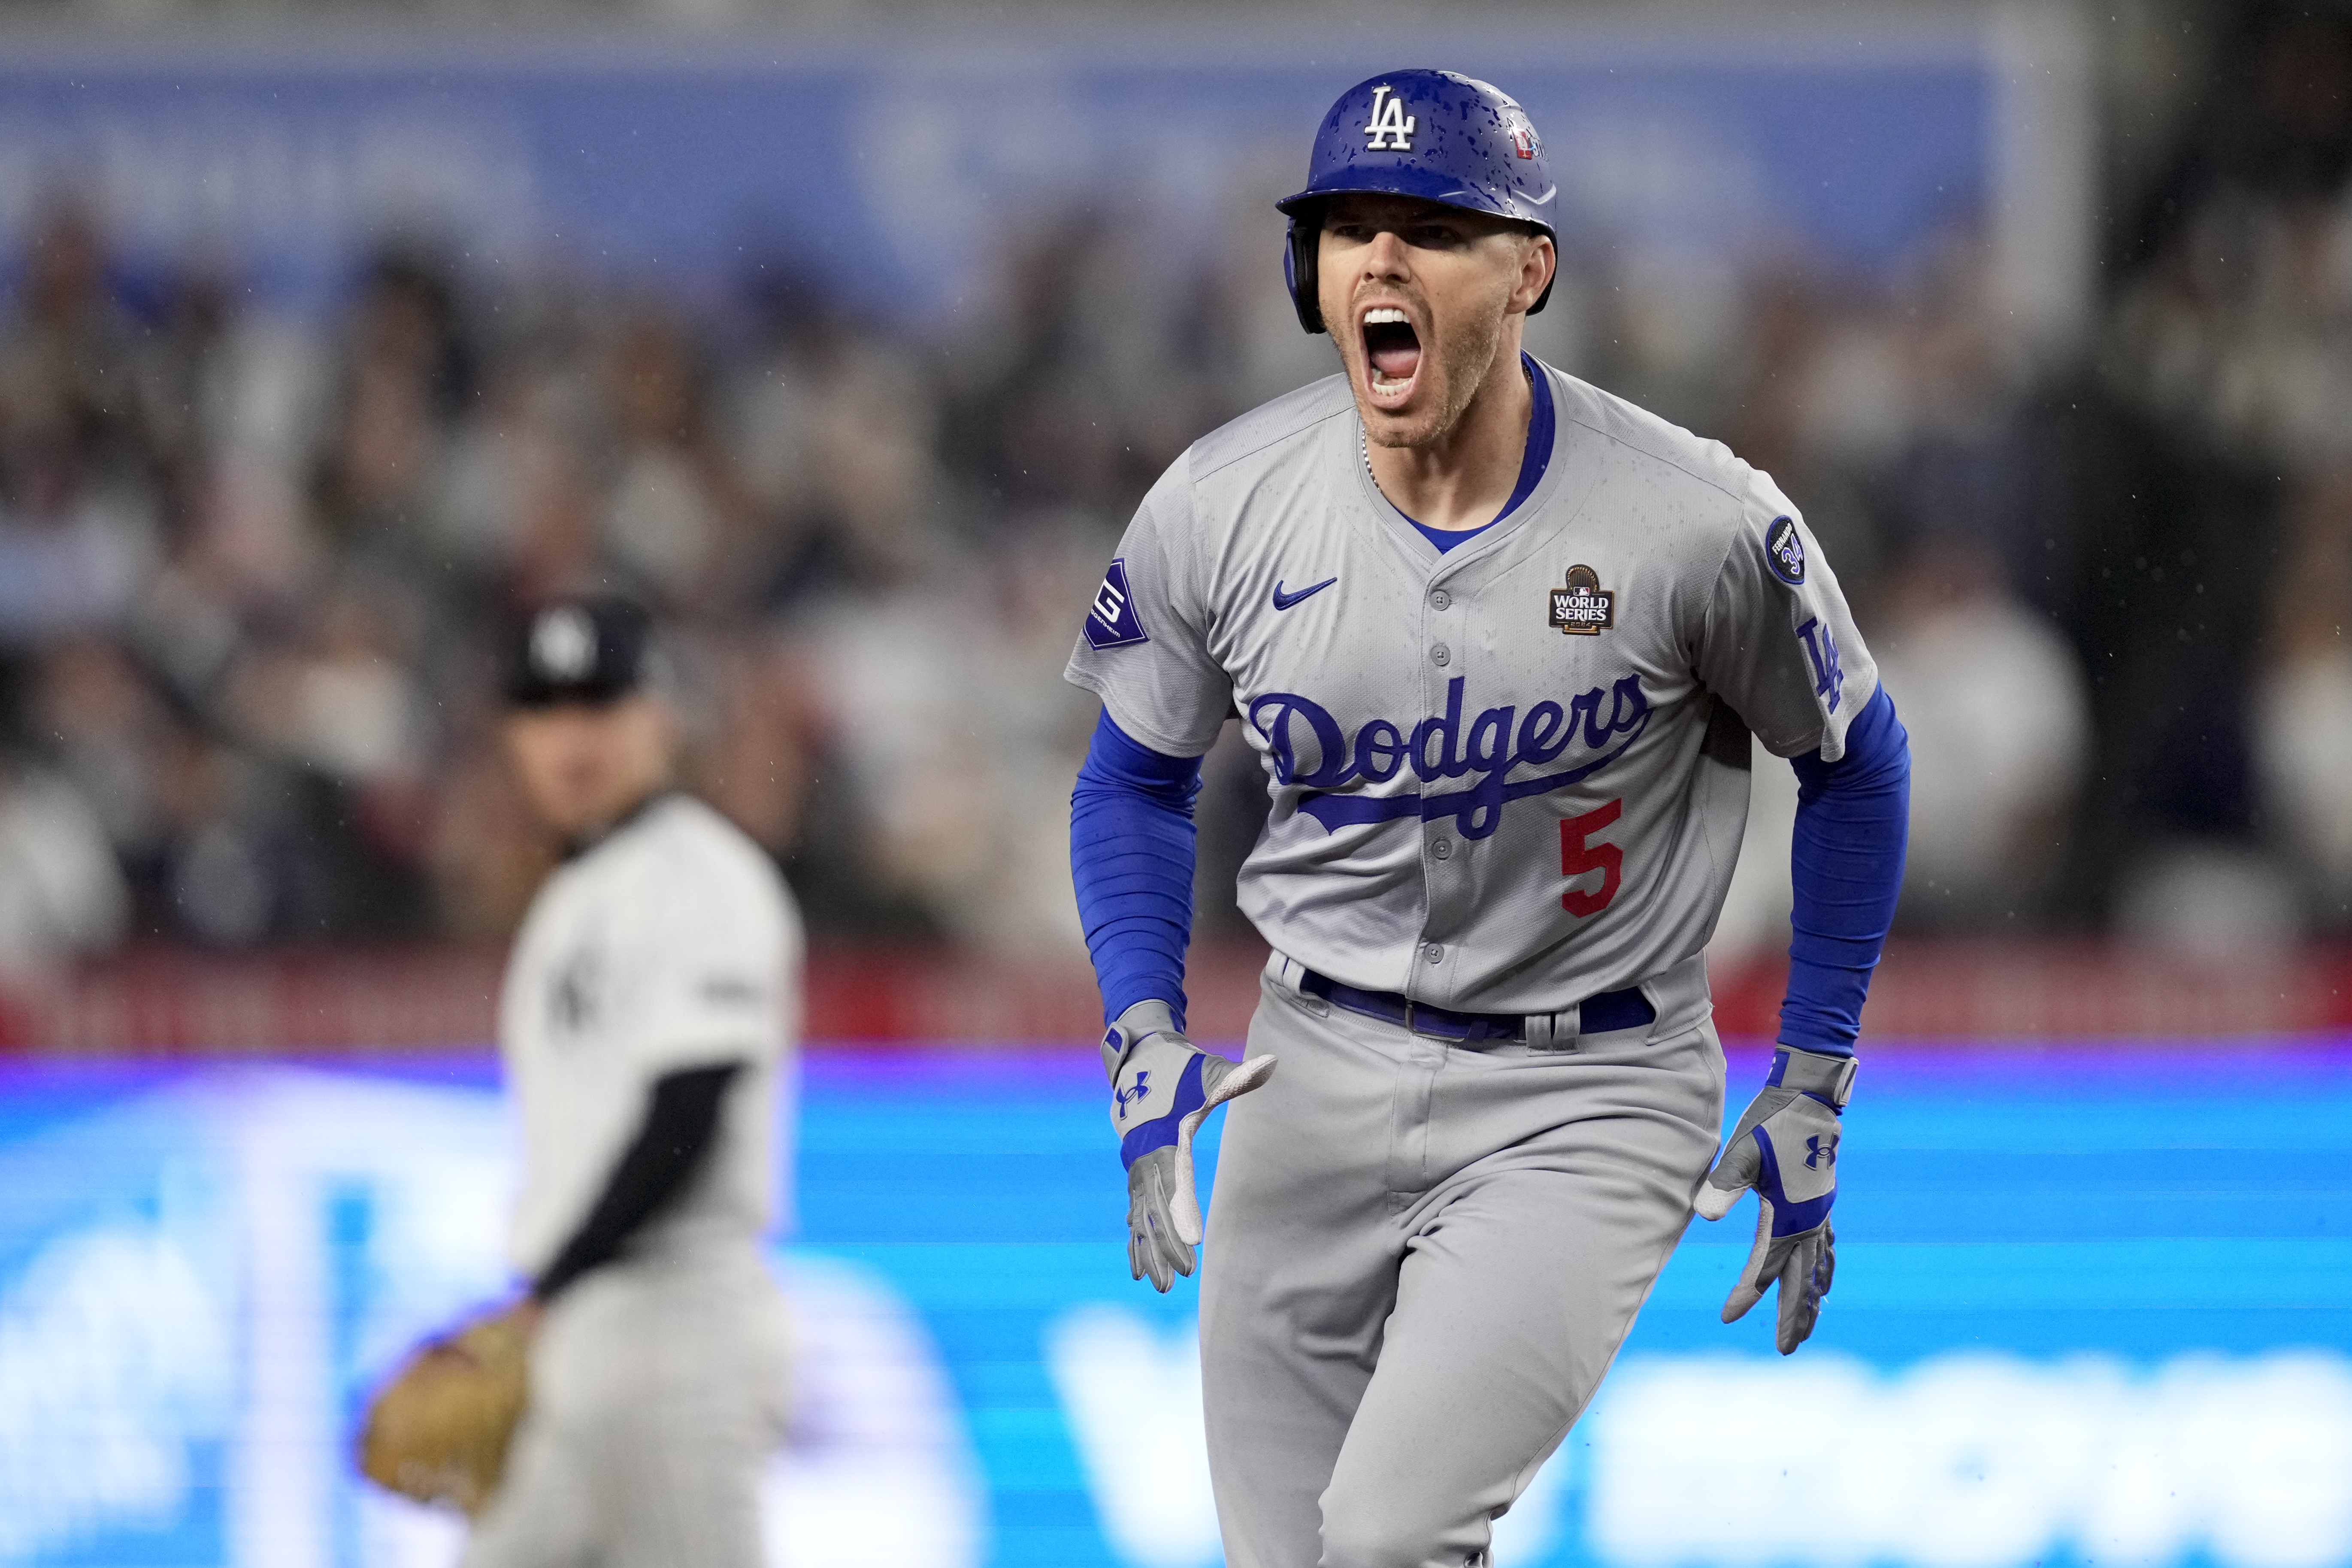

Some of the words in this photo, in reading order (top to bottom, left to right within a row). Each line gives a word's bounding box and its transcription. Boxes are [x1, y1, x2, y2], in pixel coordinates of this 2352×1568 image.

[1365, 85, 1415, 151] LA
[1771, 522, 1793, 555] FERNANDO
[1781, 533, 1803, 575] 34
[1094, 578, 1125, 623] G
[1553, 595, 1609, 609] WORLD
[1556, 607, 1607, 622] SERIES
[1249, 672, 1650, 840] Dodgers
[1559, 797, 1623, 918] 5
